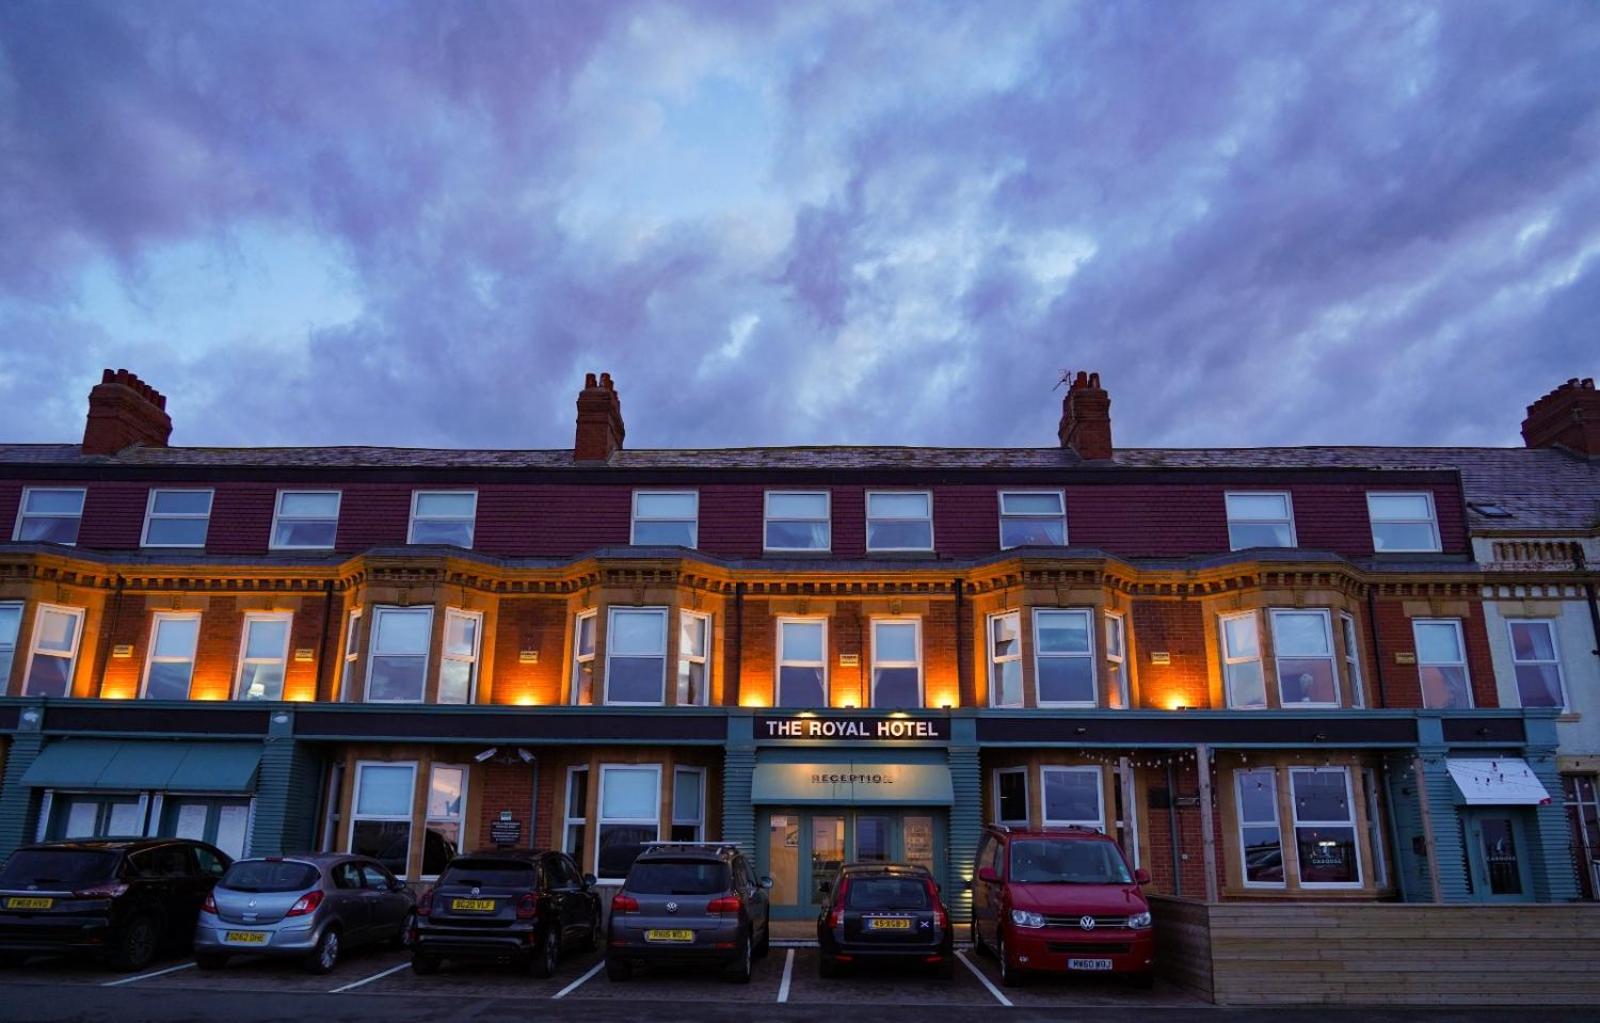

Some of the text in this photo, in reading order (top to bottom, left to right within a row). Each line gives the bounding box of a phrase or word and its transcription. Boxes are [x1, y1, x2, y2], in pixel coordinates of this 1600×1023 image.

[766, 720, 939, 737] THE ROYAL HOTEL
